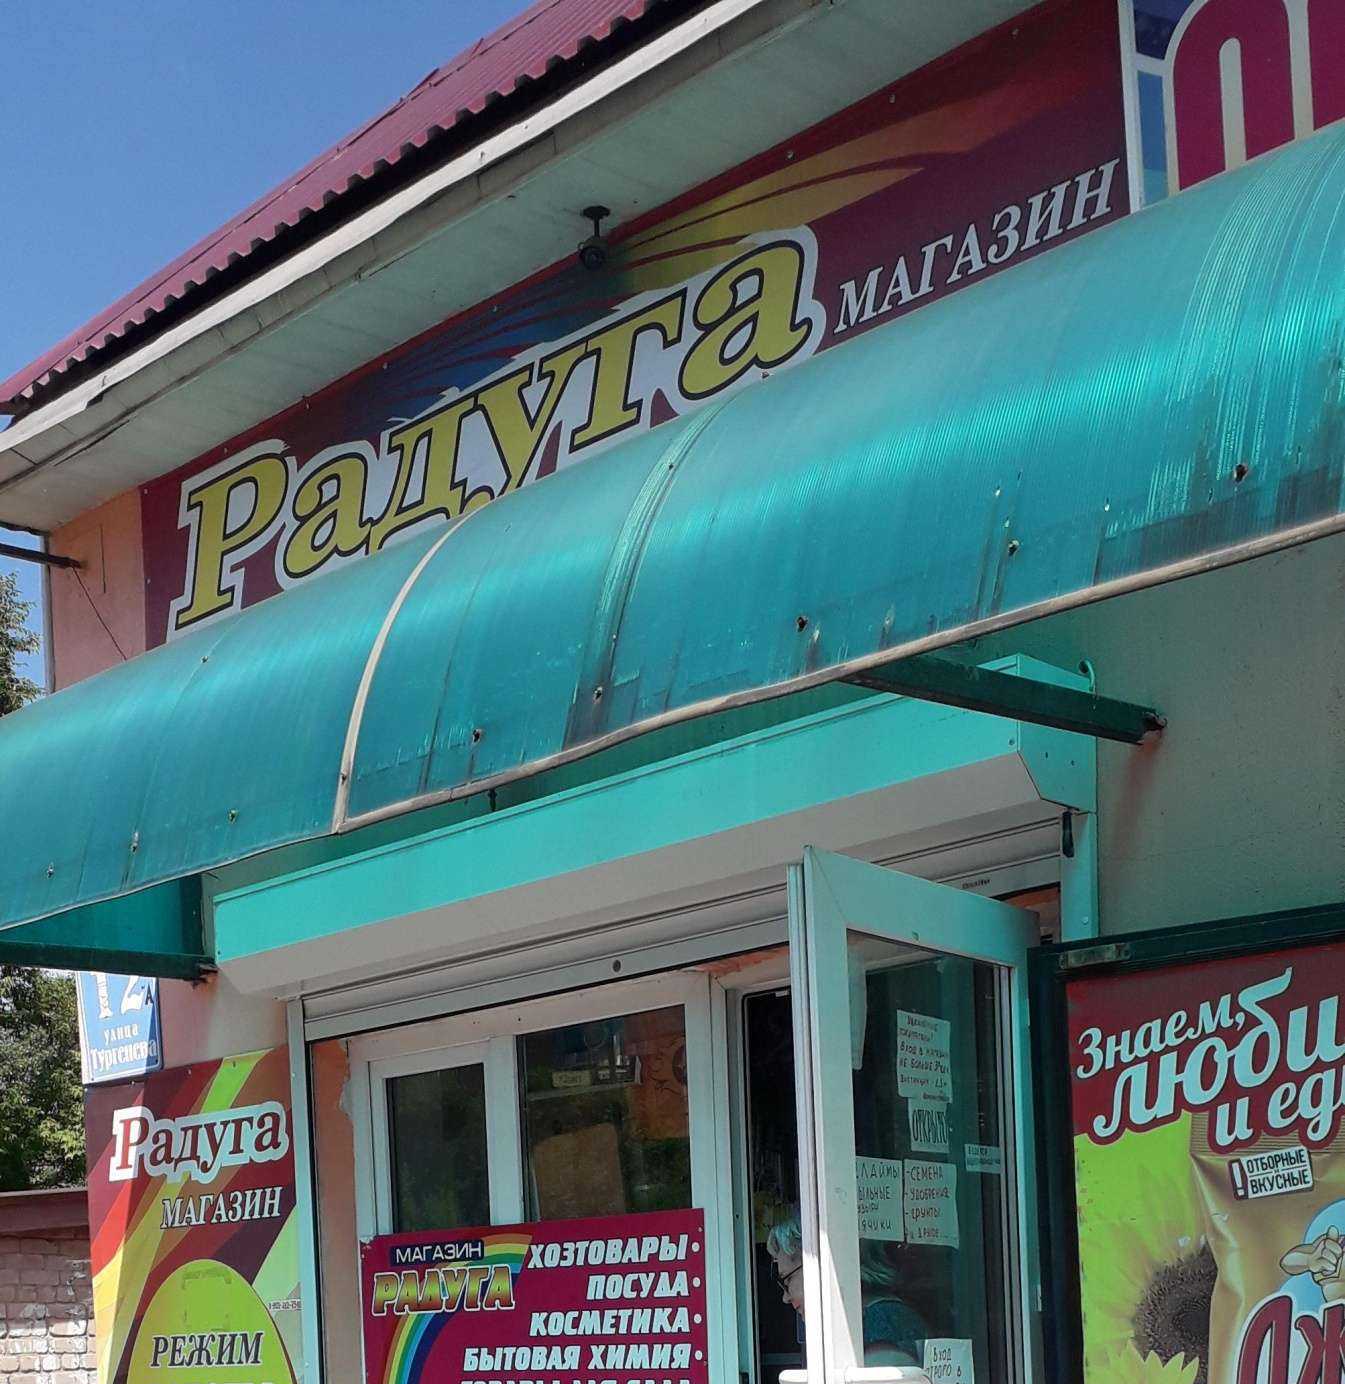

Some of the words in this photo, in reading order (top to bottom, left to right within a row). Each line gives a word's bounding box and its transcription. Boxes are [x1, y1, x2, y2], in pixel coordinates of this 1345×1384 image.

[173, 238, 814, 631] Радуга
[834, 158, 1120, 334] МАГАЗИН
[104, 1024, 138, 1045] улица
[1077, 994, 1246, 1079] Знаем,
[1093, 967, 1345, 1137] люби
[90, 1040, 158, 1071] Тургенева
[1216, 1097, 1253, 1146] и
[115, 1112, 282, 1174] Радуга
[1246, 1149, 1307, 1174] ОТБОРНЫЕ
[1250, 1169, 1311, 1195] ВКУСНЫЕ
[161, 1186, 283, 1230] МАГАЗИН
[396, 1241, 483, 1263] МАГАЗИН
[528, 1234, 689, 1269] ХОЗТОВАРЫ
[372, 1265, 516, 1317] РАДУГА
[586, 1271, 690, 1301] ПОСУДА
[529, 1307, 691, 1338] КОСМЕТИКА
[150, 1331, 264, 1368] РЕЖИМ
[463, 1347, 581, 1372] БЫТОВАЯ
[588, 1344, 692, 1370] ХИМИЯ
